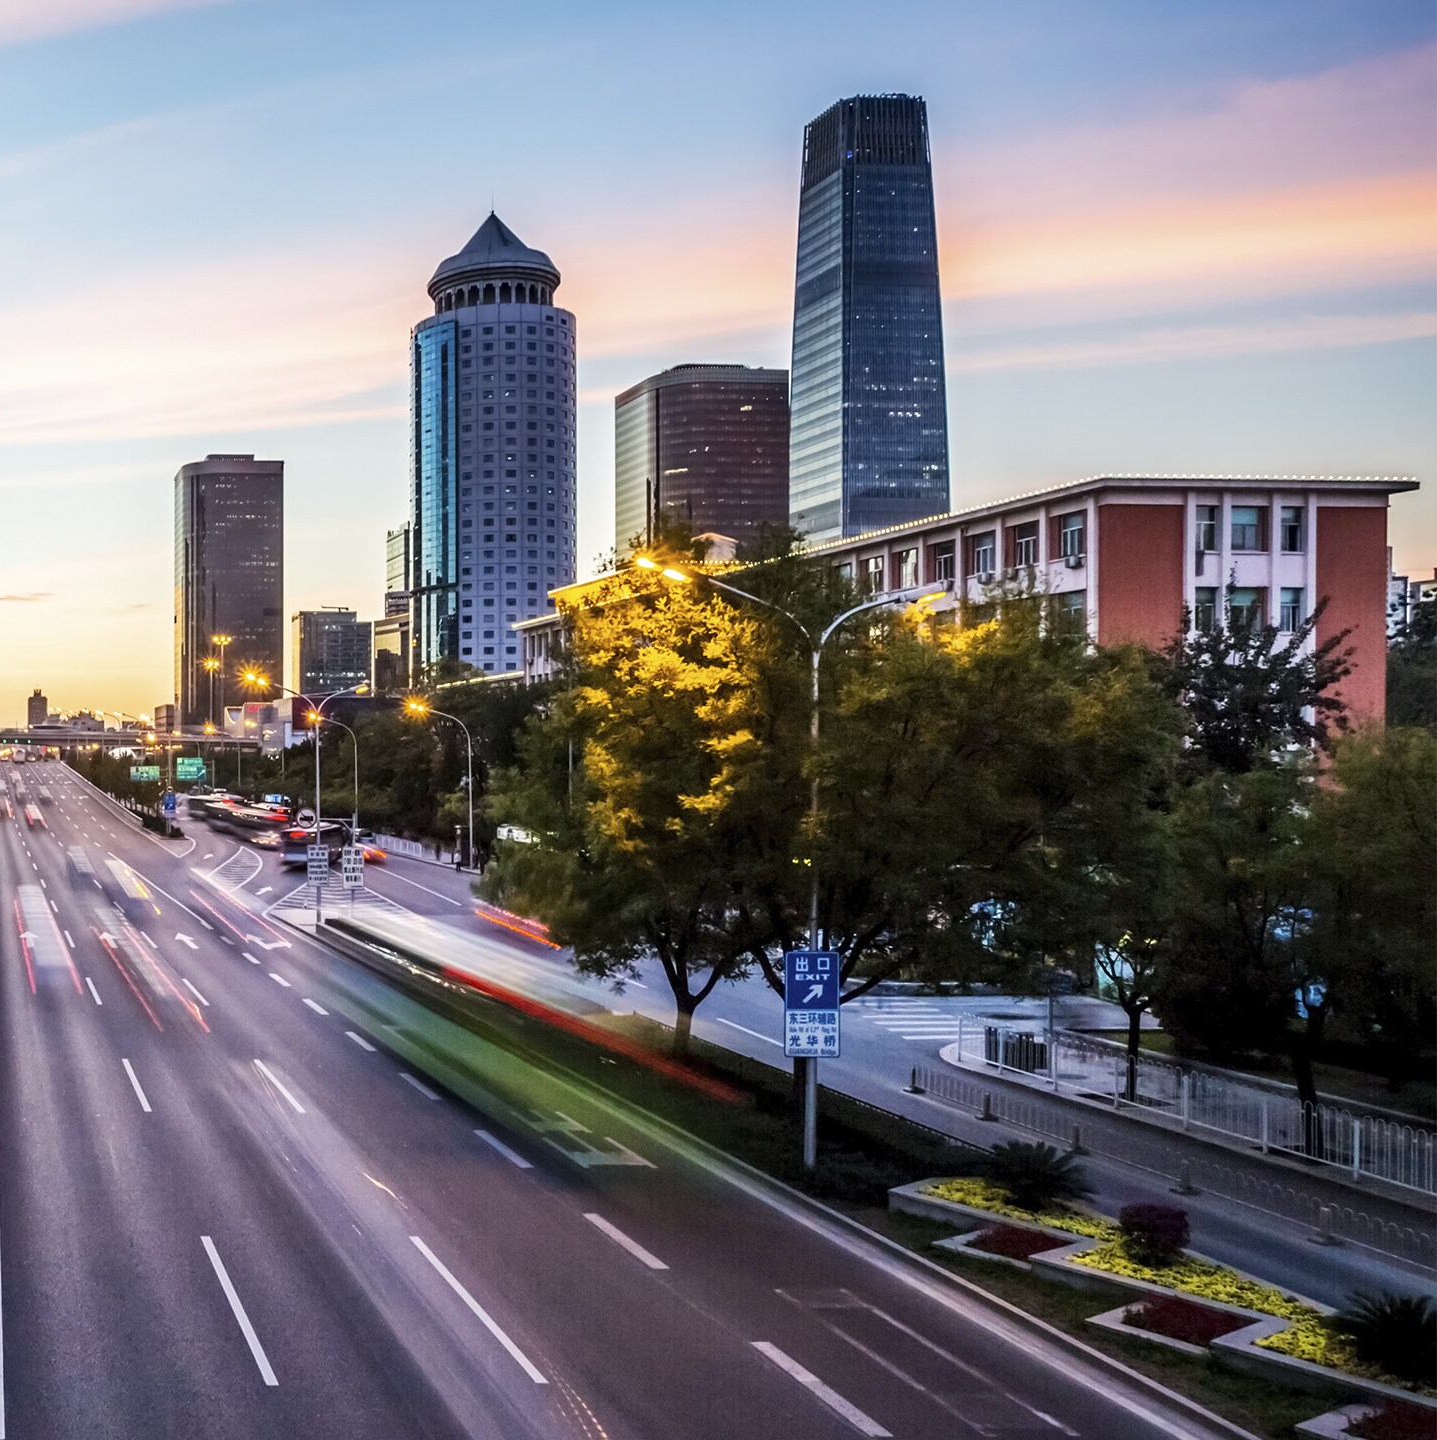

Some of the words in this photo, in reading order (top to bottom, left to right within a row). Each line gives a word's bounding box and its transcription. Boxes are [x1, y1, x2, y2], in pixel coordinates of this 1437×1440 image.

[796, 957, 829, 971] 出口
[789, 1012, 836, 1025] 东三环辅路
[789, 1035, 836, 1047] 光华桥
